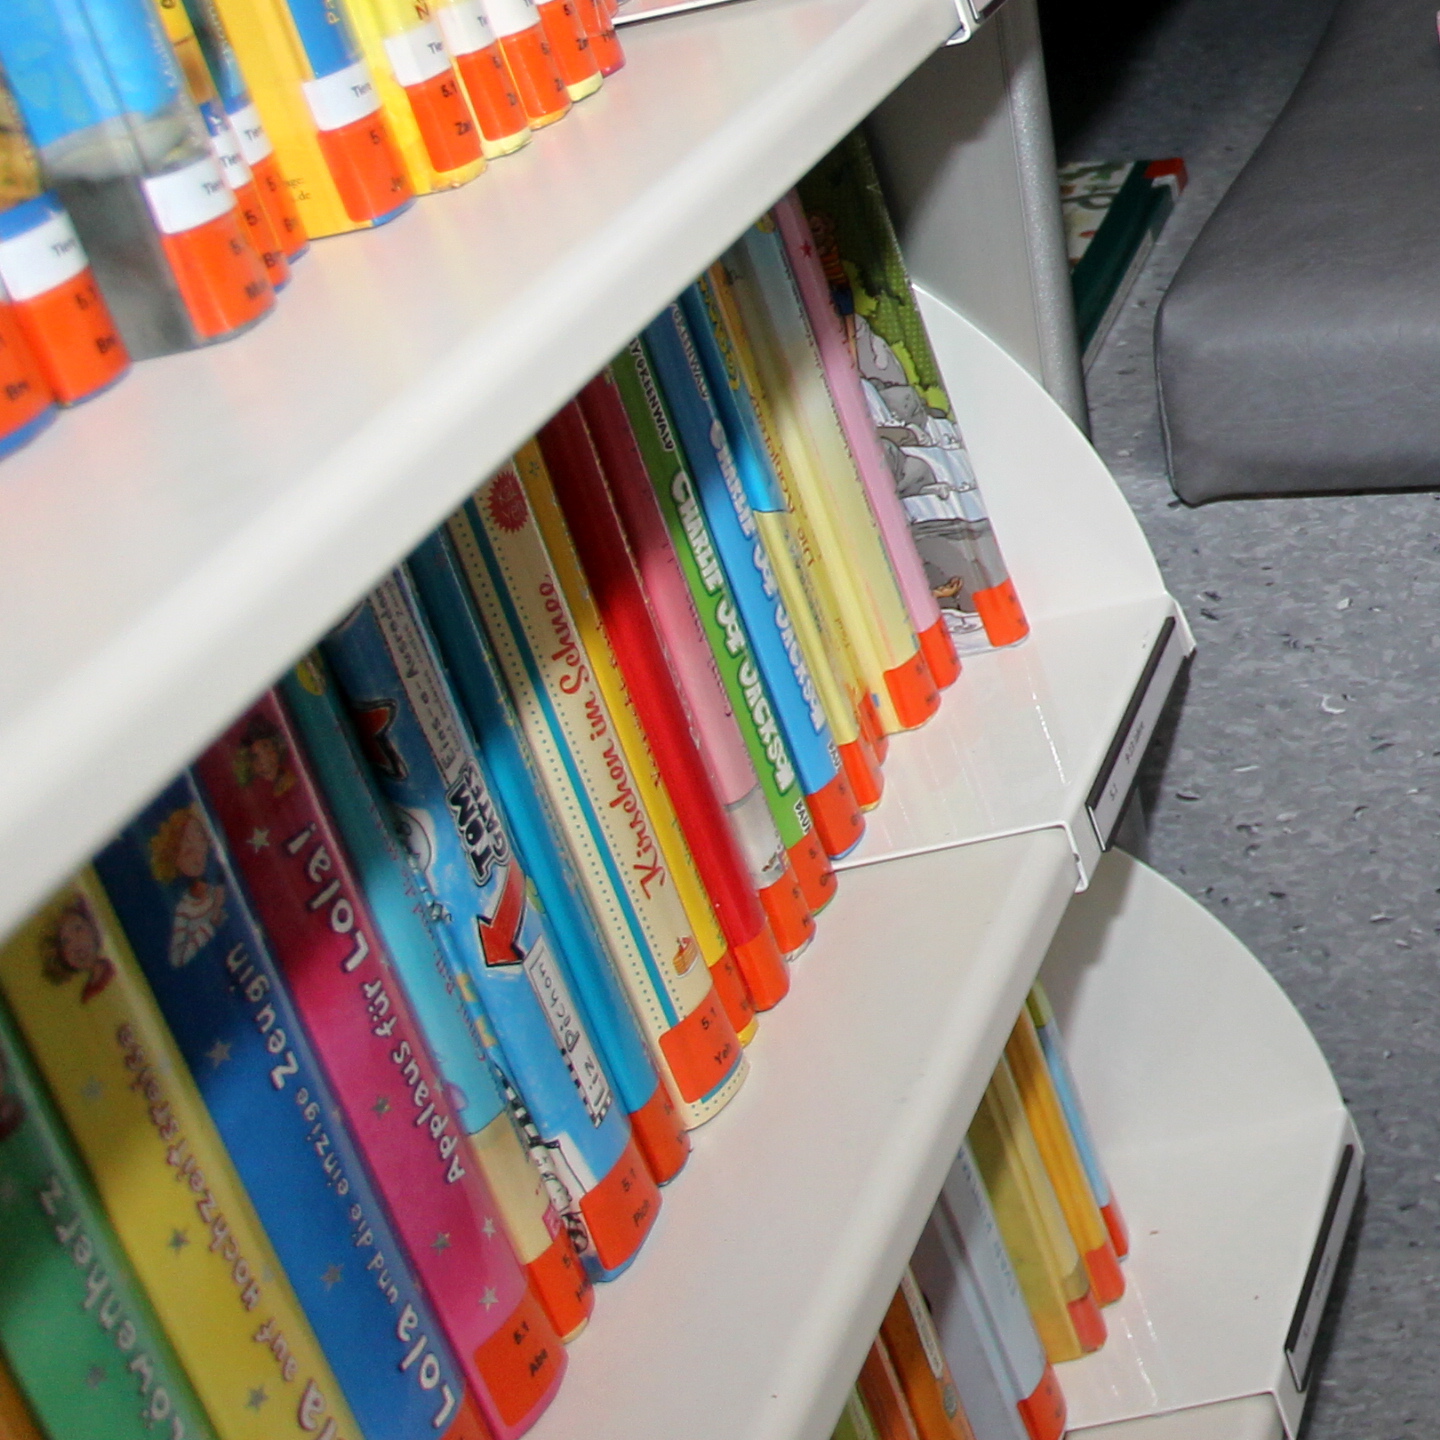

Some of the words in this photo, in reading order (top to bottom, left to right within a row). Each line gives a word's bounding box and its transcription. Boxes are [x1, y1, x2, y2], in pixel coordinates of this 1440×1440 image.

[630, 357, 678, 455] GREENWALD
[699, 417, 764, 541] CHARLIE
[765, 597, 836, 734] JACKSON
[518, 571, 598, 701] Schnee
[665, 463, 732, 598] CHARLIE
[707, 591, 752, 660] JOE
[731, 653, 799, 795] JACKSON
[573, 689, 612, 742] im
[440, 783, 500, 881] TOM
[456, 761, 514, 861] GATES
[586, 737, 672, 892] Kirschen
[279, 819, 378, 976] Lola!
[210, 936, 315, 1091] Zeugin
[352, 974, 403, 1040] für
[531, 957, 584, 1047] Pichon
[701, 1006, 717, 1030] 5.1
[381, 1035, 473, 1186] Applaus
[572, 1054, 611, 1107] Liz
[283, 1084, 359, 1200] einzige
[621, 1167, 636, 1193] 5.1
[338, 1201, 379, 1251] die
[361, 1249, 404, 1308] und
[246, 1314, 304, 1390] auf
[376, 1300, 467, 1431] Lola
